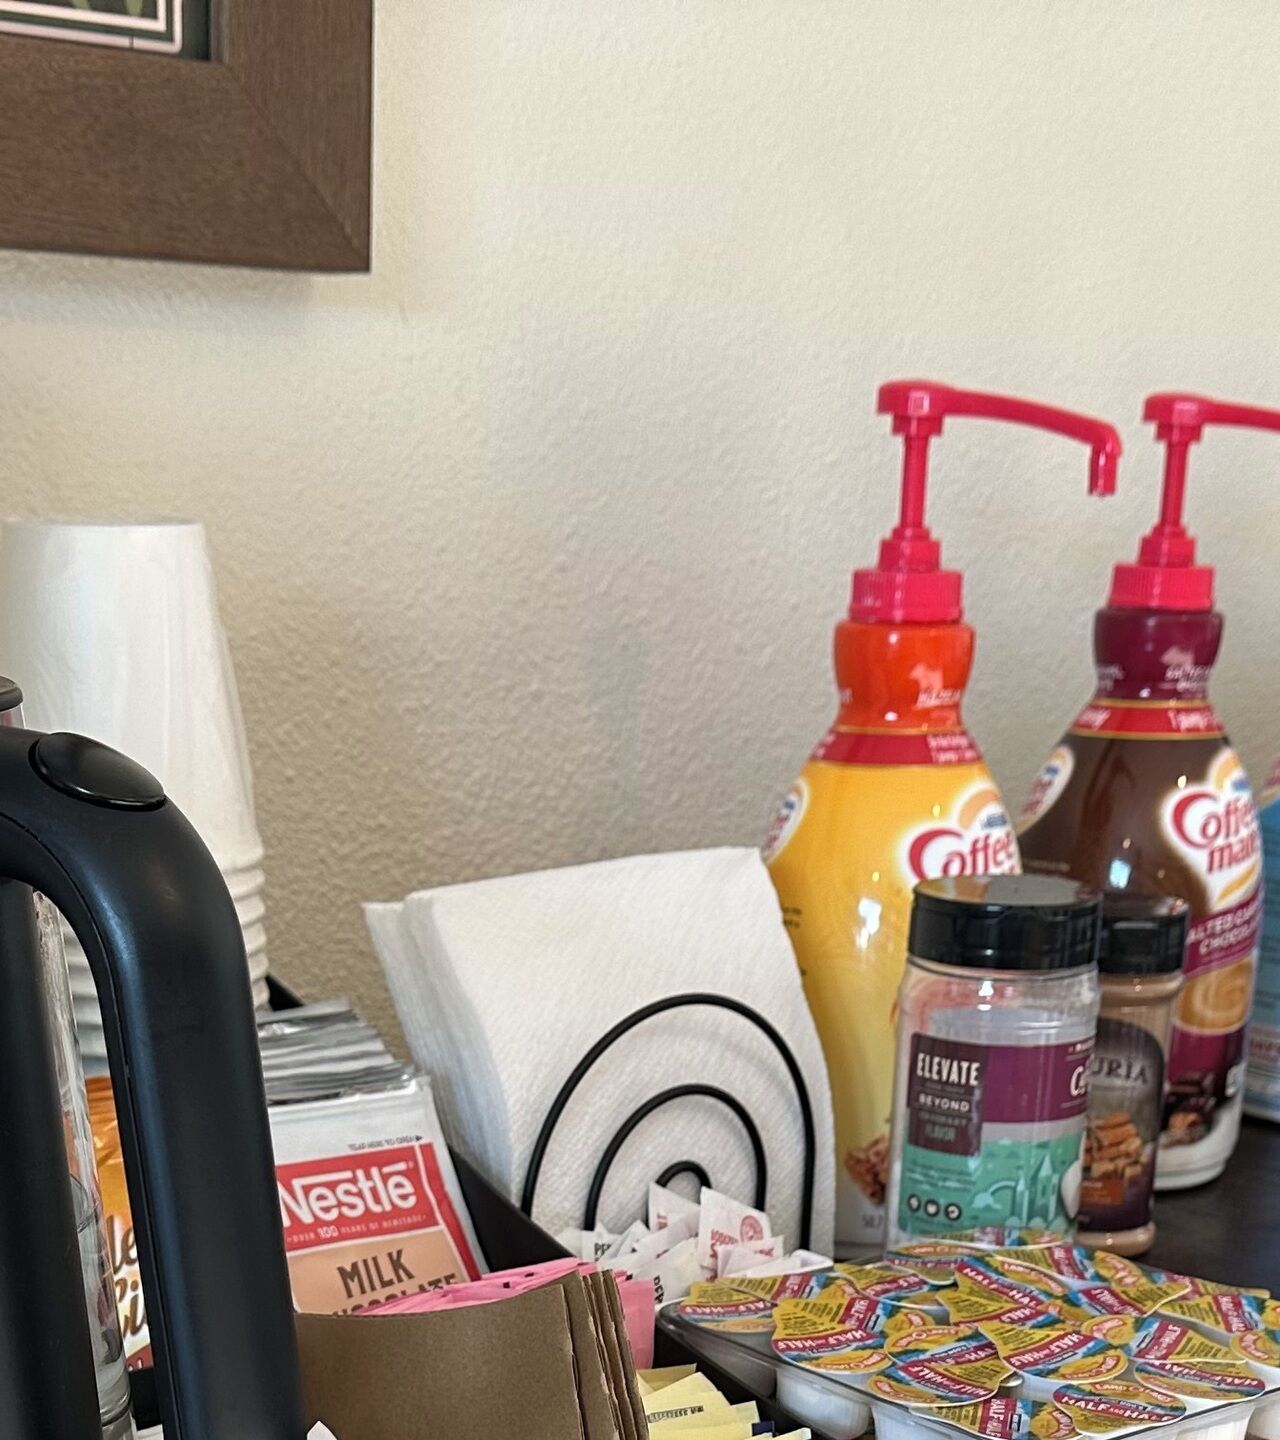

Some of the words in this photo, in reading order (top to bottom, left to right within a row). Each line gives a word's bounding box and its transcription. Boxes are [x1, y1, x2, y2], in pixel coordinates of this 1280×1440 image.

[916, 1052, 981, 1086] ELEVATE
[919, 1092, 970, 1113] BEYOND
[337, 1249, 416, 1300] MILK
[1061, 1396, 1110, 1411] HALF
